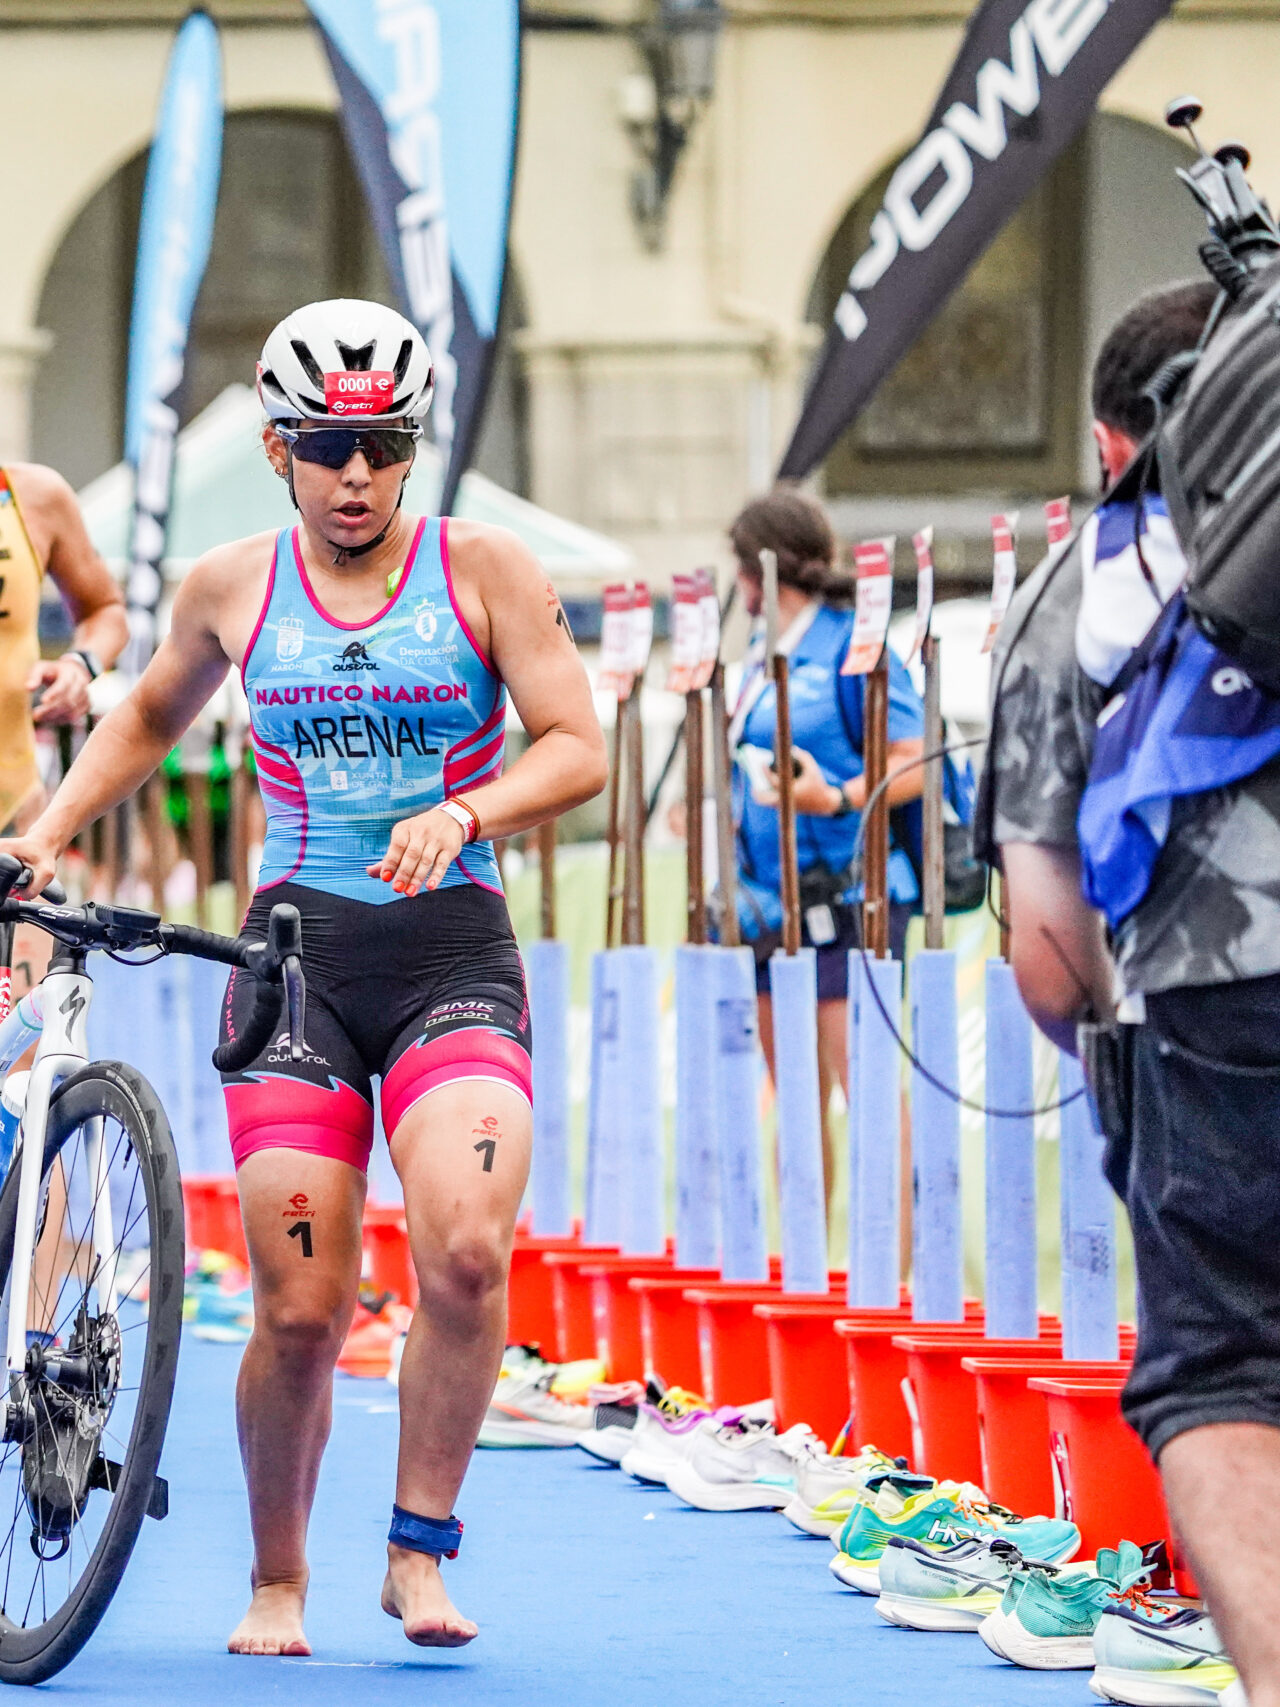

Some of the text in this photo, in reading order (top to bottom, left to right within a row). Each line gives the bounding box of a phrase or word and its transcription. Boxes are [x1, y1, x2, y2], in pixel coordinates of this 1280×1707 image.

[338, 378, 372, 392] 0001
[256, 682, 468, 706] NAUTICO NARON
[293, 714, 439, 760] ARENAL
[473, 1139, 496, 1173] 1
[287, 1221, 313, 1258] 1
